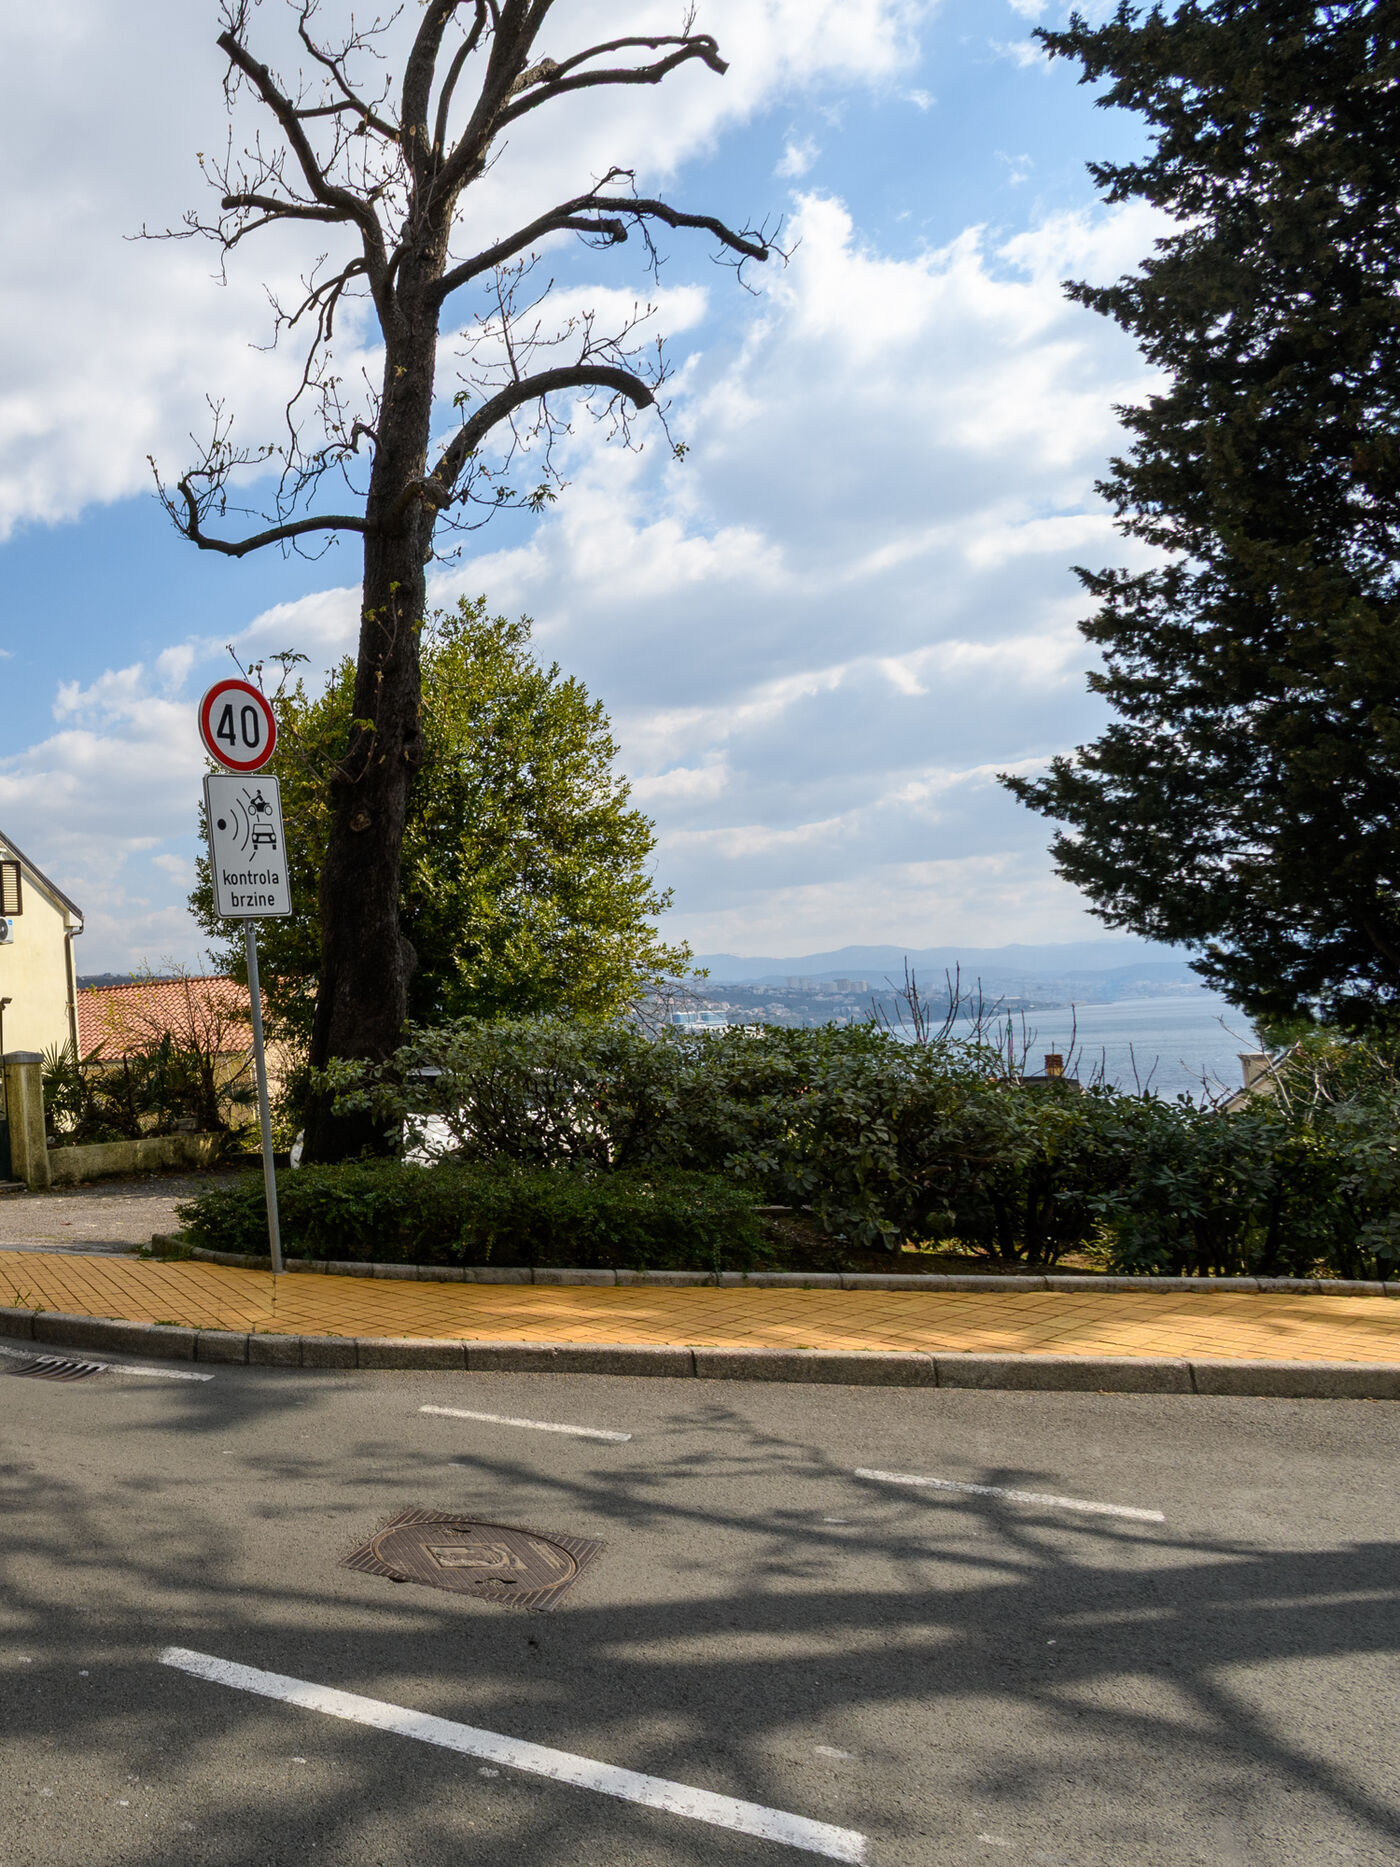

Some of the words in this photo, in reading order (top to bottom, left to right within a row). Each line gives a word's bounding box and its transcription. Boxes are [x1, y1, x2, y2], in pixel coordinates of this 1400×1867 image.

[217, 704, 260, 748] 40
[223, 869, 279, 885] kontrola
[231, 892, 275, 907] brzine
